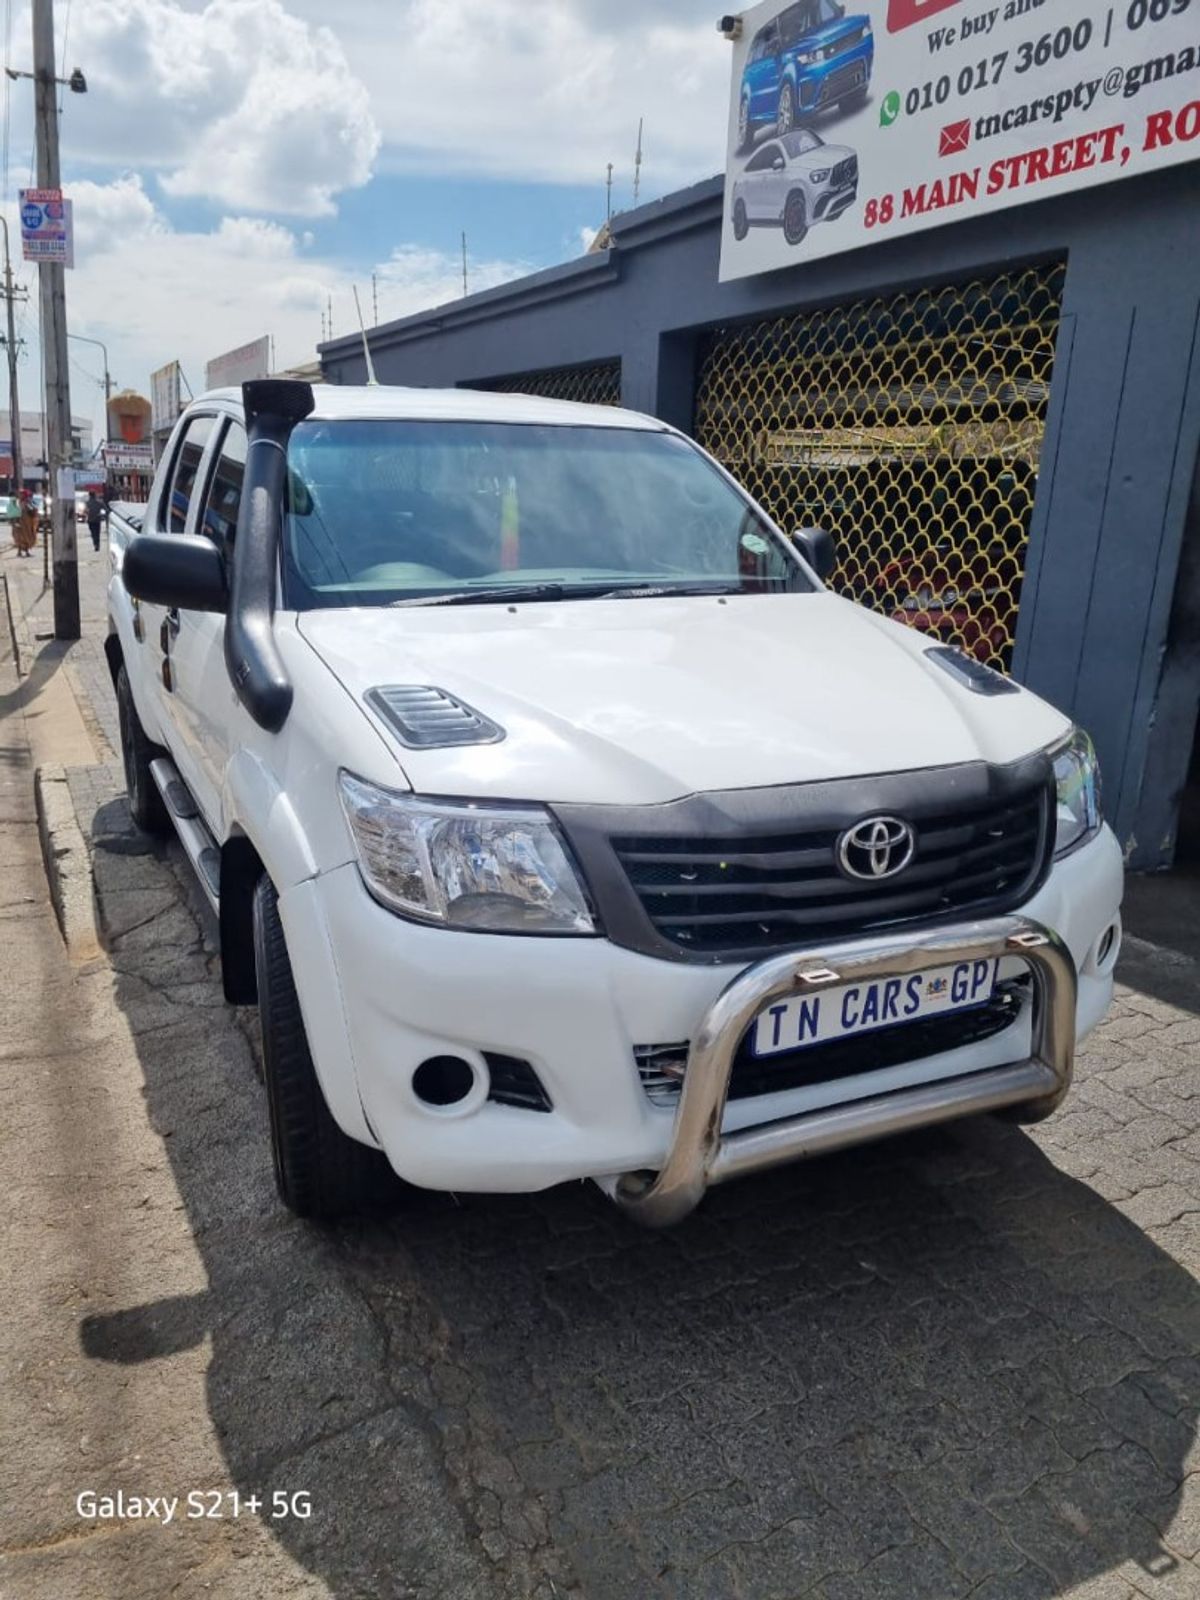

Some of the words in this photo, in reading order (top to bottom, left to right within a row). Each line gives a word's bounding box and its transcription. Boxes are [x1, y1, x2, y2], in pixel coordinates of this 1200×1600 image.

[906, 75, 950, 115] 010
[957, 51, 1009, 95] 017
[1014, 18, 1092, 73] 3600
[927, 26, 956, 54] We
[960, 8, 1000, 40] buy
[864, 194, 894, 229] 88
[900, 167, 981, 218] MAIN
[986, 123, 1130, 196] STREET,
[841, 974, 923, 1029] CARS
[951, 958, 989, 1003] GP
